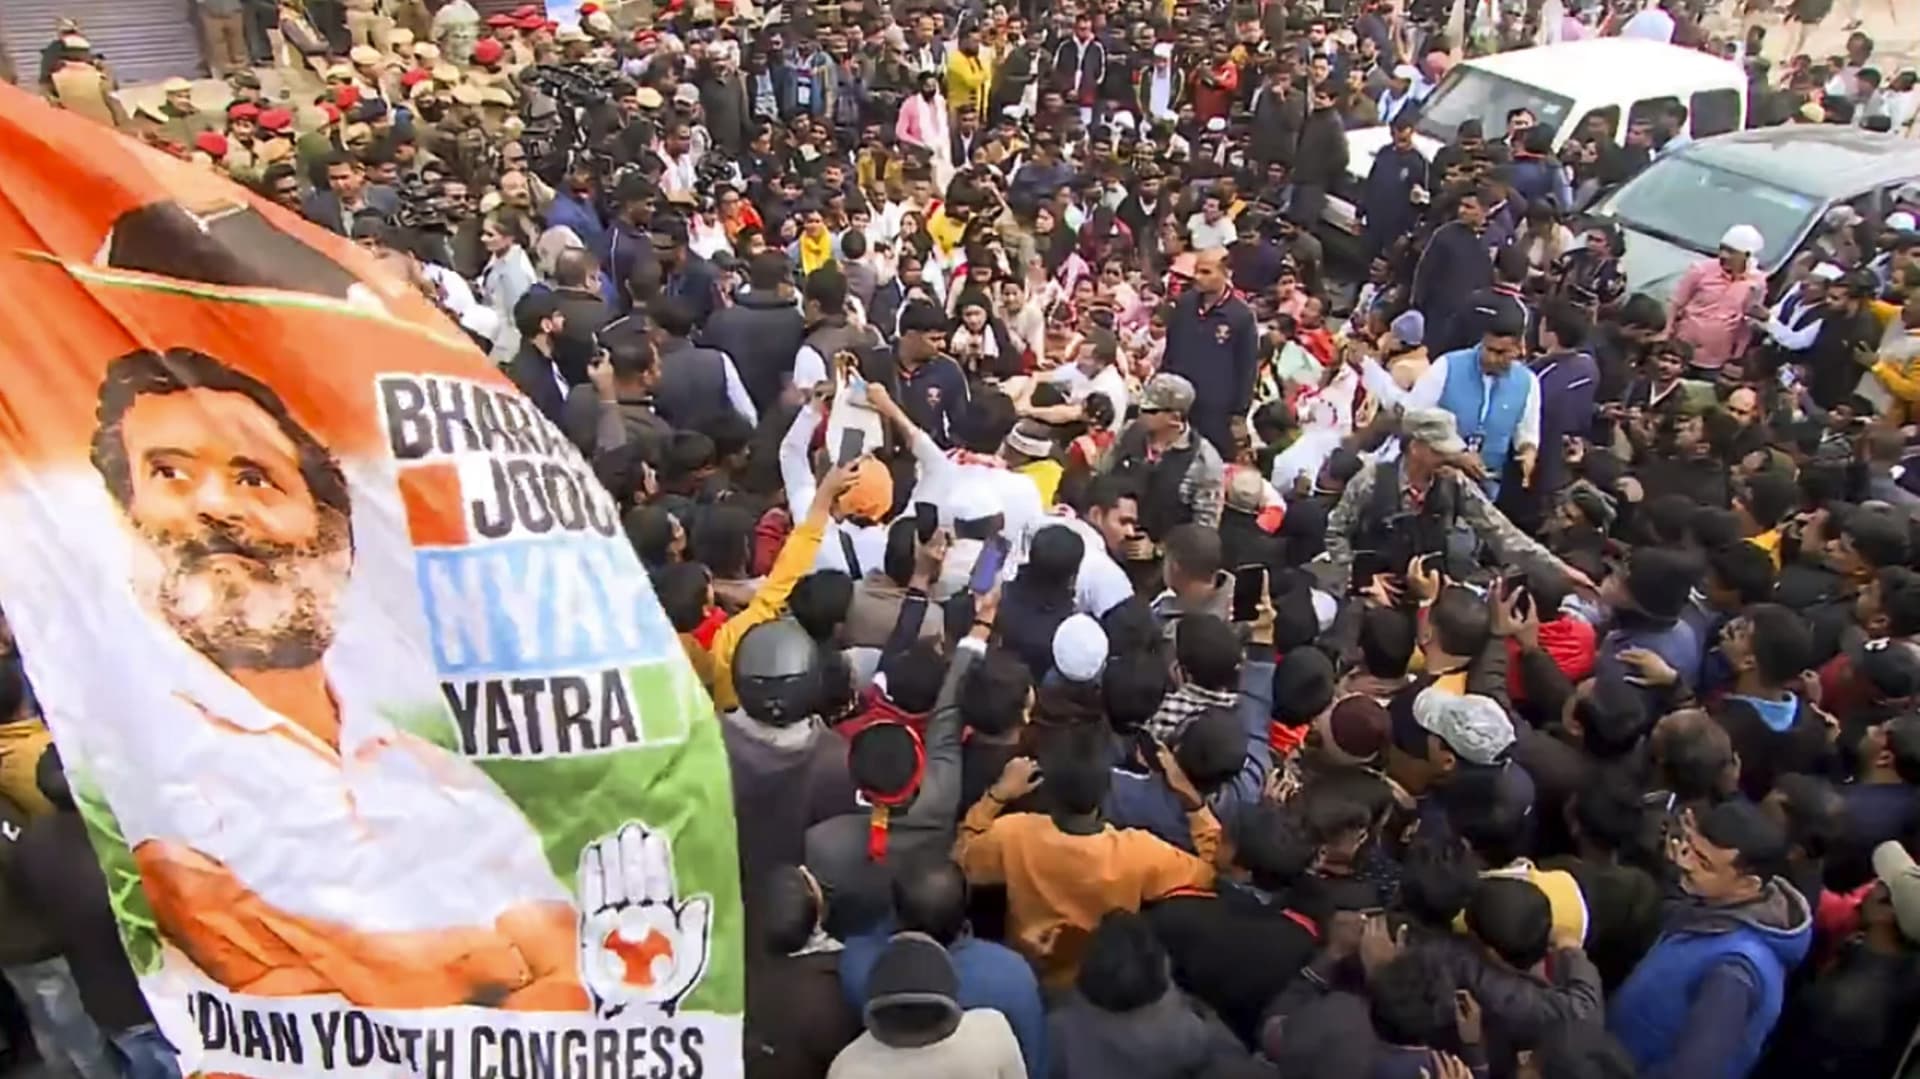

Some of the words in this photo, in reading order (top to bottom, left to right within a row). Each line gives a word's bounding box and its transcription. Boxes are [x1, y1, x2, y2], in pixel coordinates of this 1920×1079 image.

[427, 546, 649, 664] NYAY
[440, 667, 639, 755] YATRA
[188, 990, 304, 1065] DIAN
[311, 1010, 454, 1079] YOUTH
[470, 1025, 704, 1079] CONGRESS
